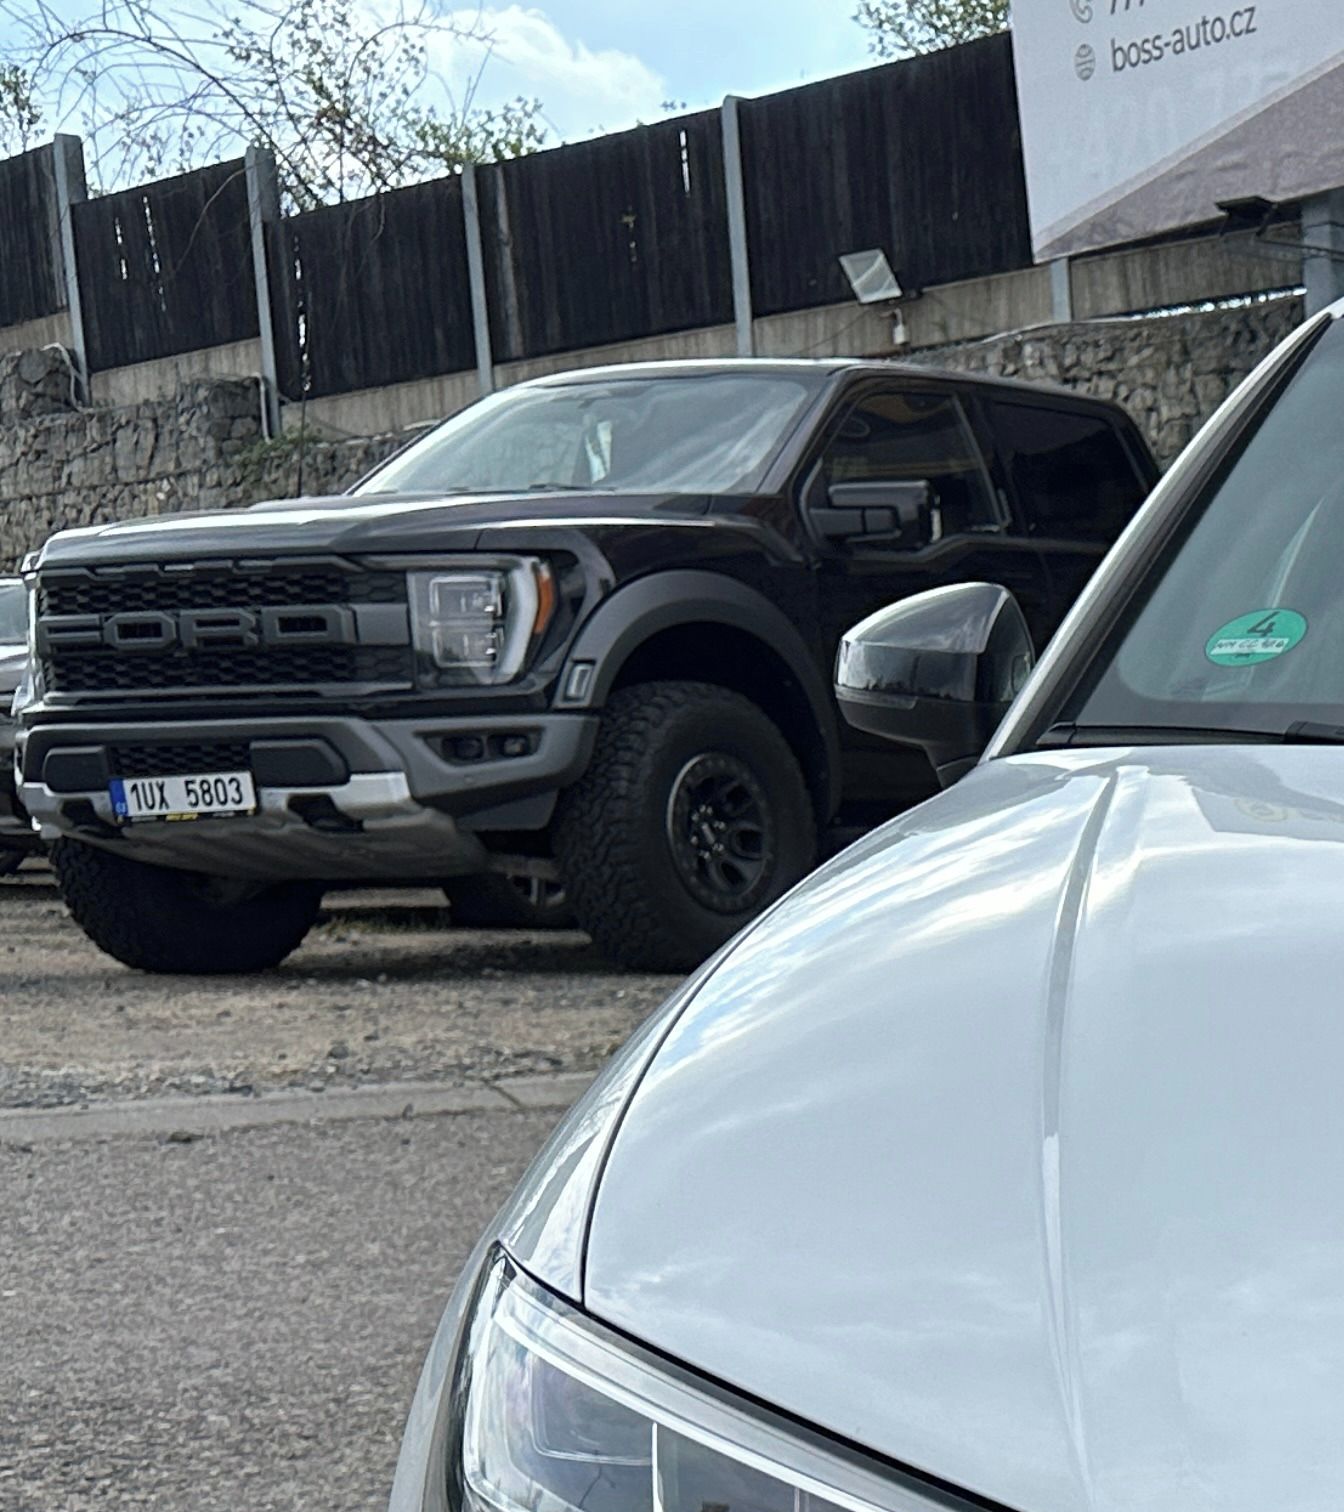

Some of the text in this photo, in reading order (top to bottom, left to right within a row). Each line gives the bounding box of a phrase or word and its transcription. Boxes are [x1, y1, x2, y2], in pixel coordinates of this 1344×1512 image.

[1110, 6, 1257, 72] boss-auto.cz
[39, 604, 352, 654] FORD
[1246, 611, 1280, 637] 4
[130, 777, 243, 811] 1UX 5803
